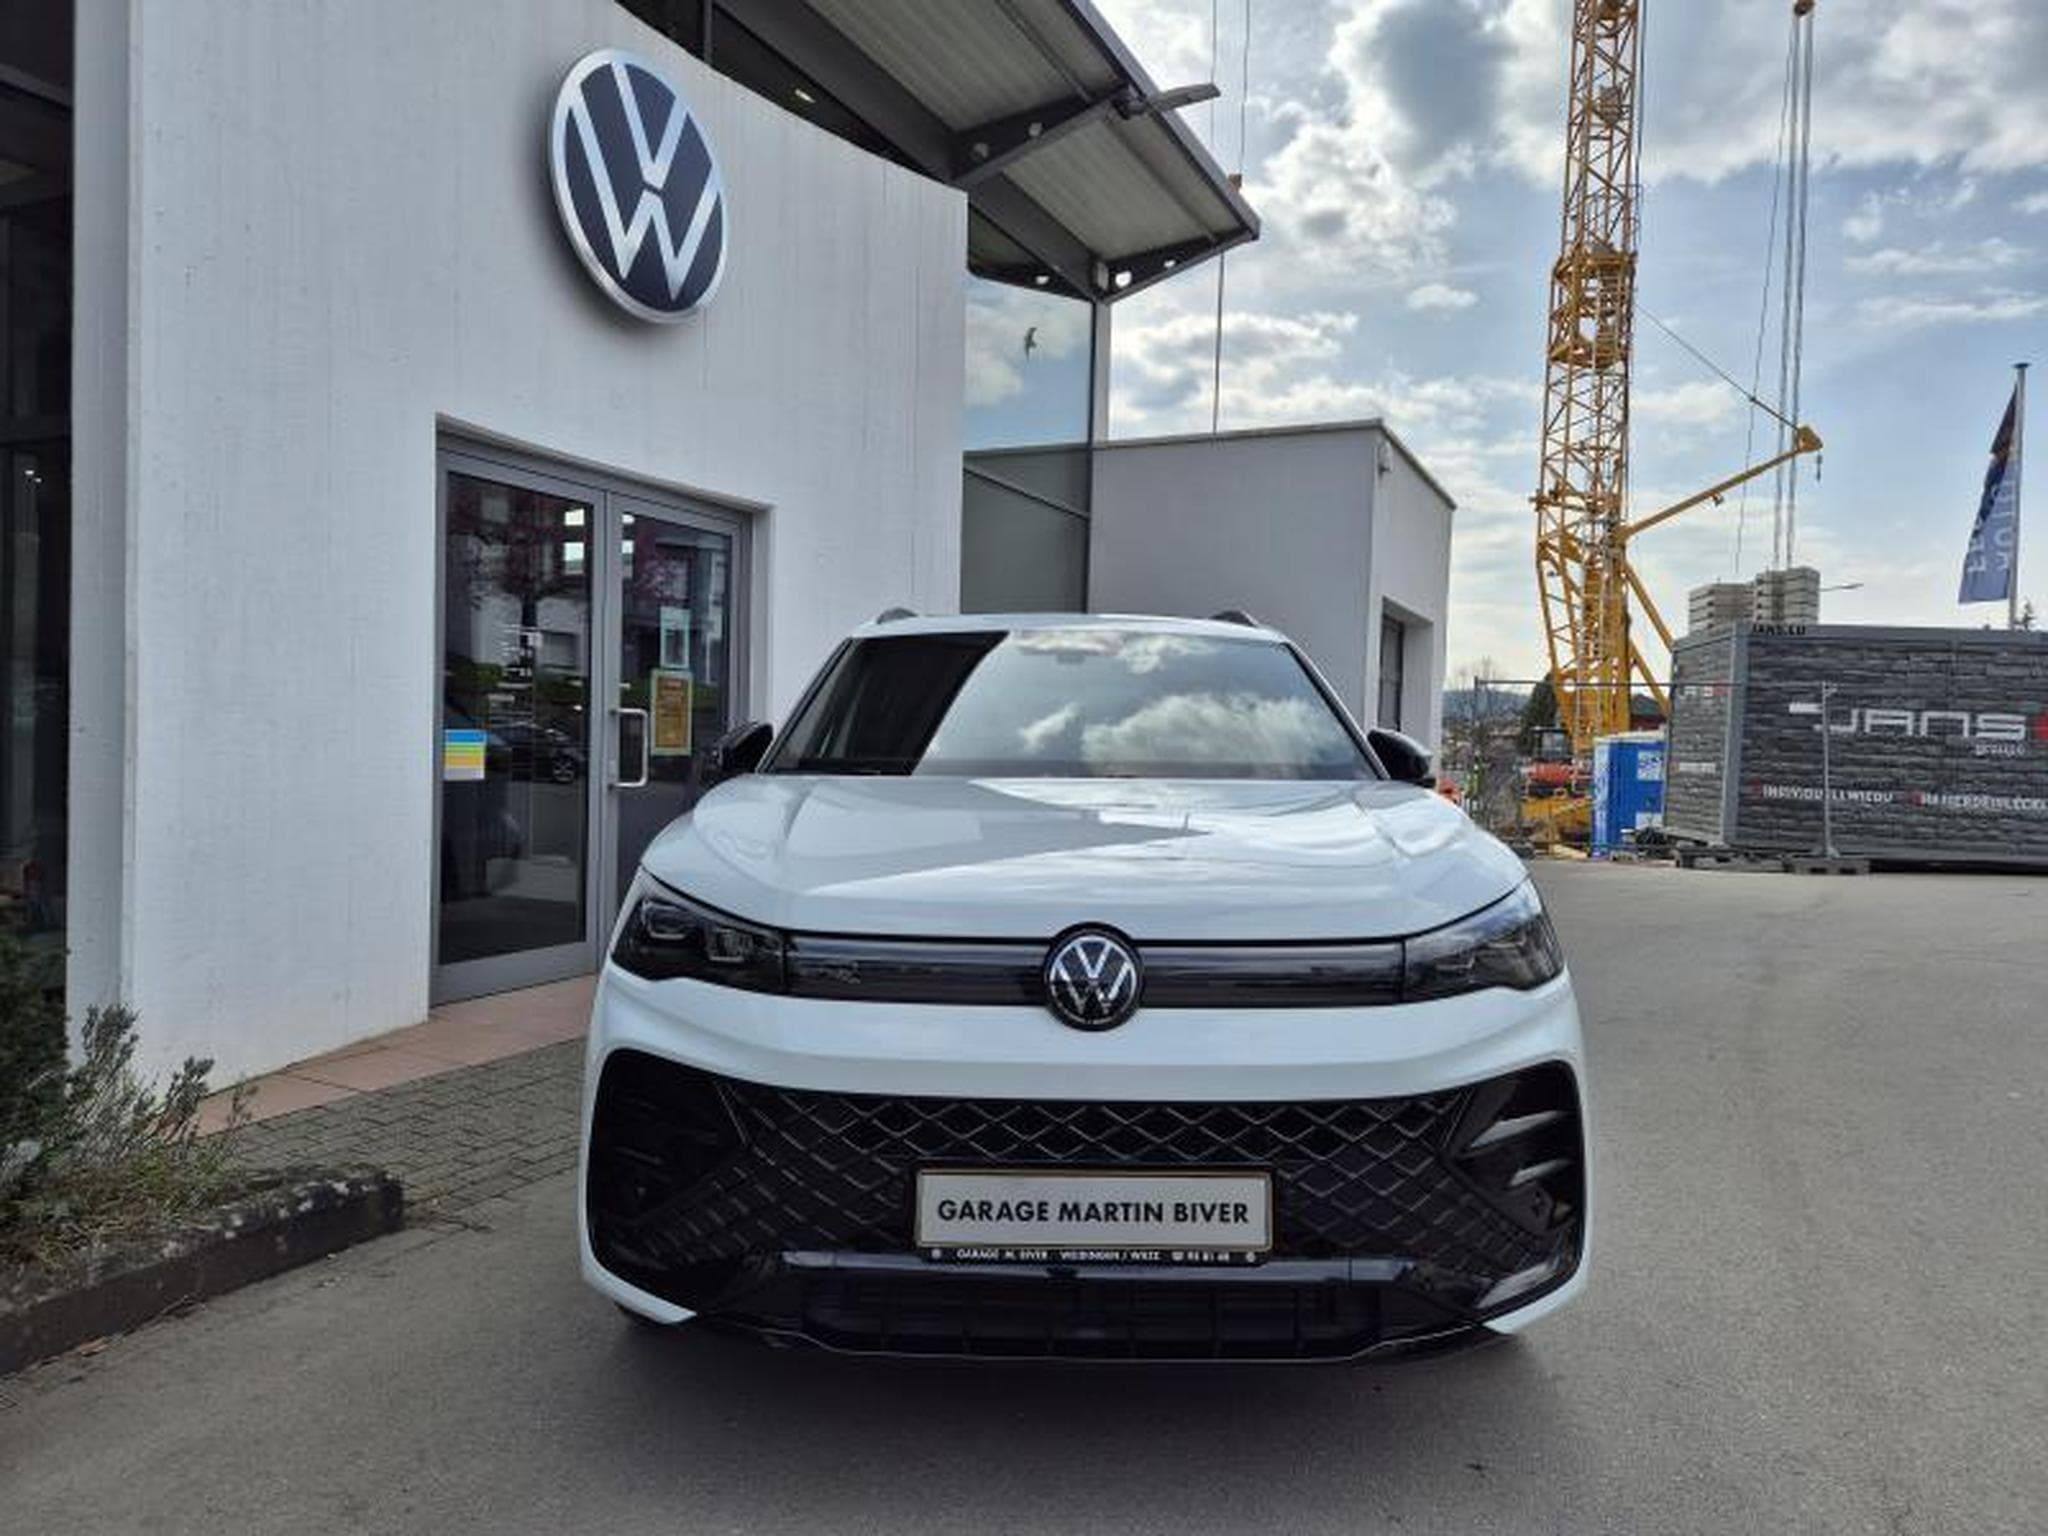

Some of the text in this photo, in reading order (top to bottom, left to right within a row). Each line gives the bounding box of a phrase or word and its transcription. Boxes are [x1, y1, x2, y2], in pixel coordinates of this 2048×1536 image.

[555, 56, 724, 304] VW
[1790, 703, 2027, 740] JANS
[1053, 937, 1135, 1016] VW
[937, 1199, 1249, 1224] GARAGE MARTIN BIVER
